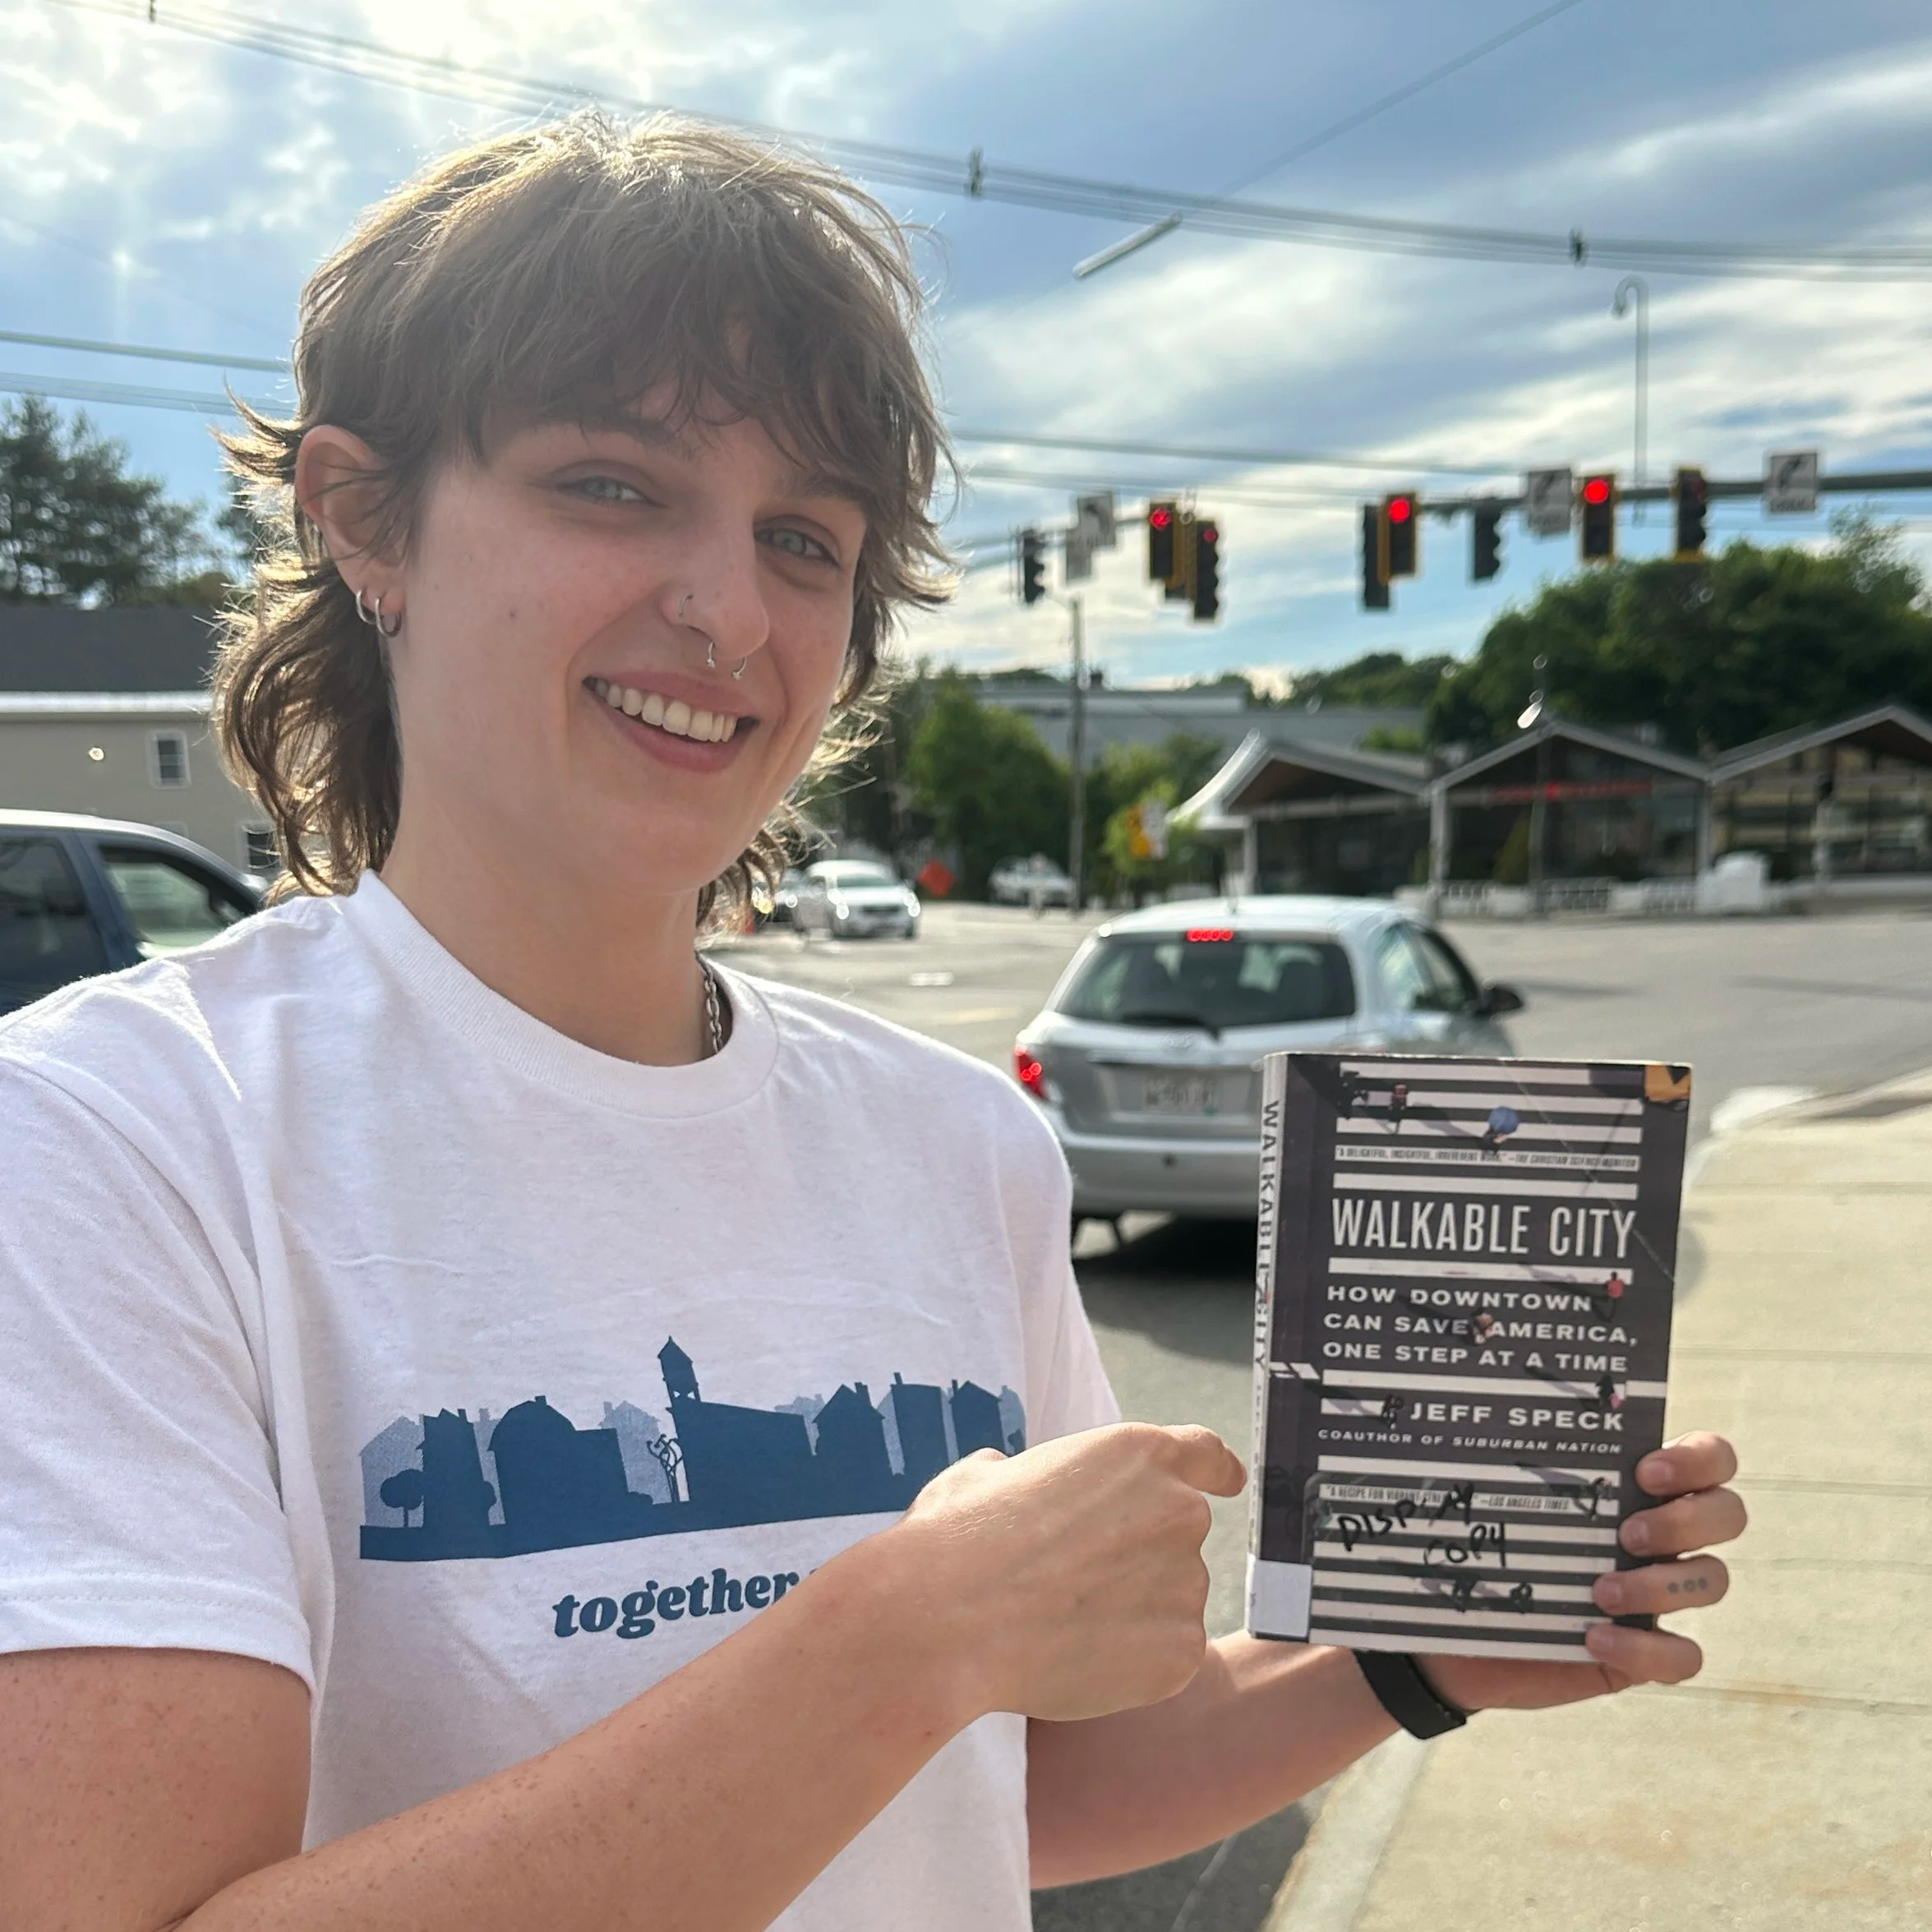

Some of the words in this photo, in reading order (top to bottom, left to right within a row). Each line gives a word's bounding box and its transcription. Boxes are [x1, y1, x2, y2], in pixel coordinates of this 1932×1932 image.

[1332, 1198, 1532, 1254] WALKABLE
[1548, 1206, 1638, 1258] CITY
[1327, 1285, 1397, 1303] HOW
[1410, 1289, 1592, 1312] DOWNTOWN
[1324, 1313, 1382, 1330] CAN
[1395, 1316, 1469, 1335] SAVE
[1488, 1321, 1638, 1348] AMERICA,
[1322, 1341, 1381, 1359] ONE
[1395, 1344, 1469, 1364] STEP
[1478, 1349, 1515, 1366] AT
[1524, 1352, 1544, 1368] A
[1555, 1353, 1628, 1372] TIME
[1410, 1402, 1492, 1423] JEFF
[1508, 1409, 1624, 1432] SPECK
[1318, 1429, 1413, 1444] COAUTHOR
[1421, 1434, 1444, 1446] OF
[1452, 1436, 1549, 1451] SUBURBAN
[1556, 1441, 1622, 1455] NATION
[552, 1567, 800, 1639] together
